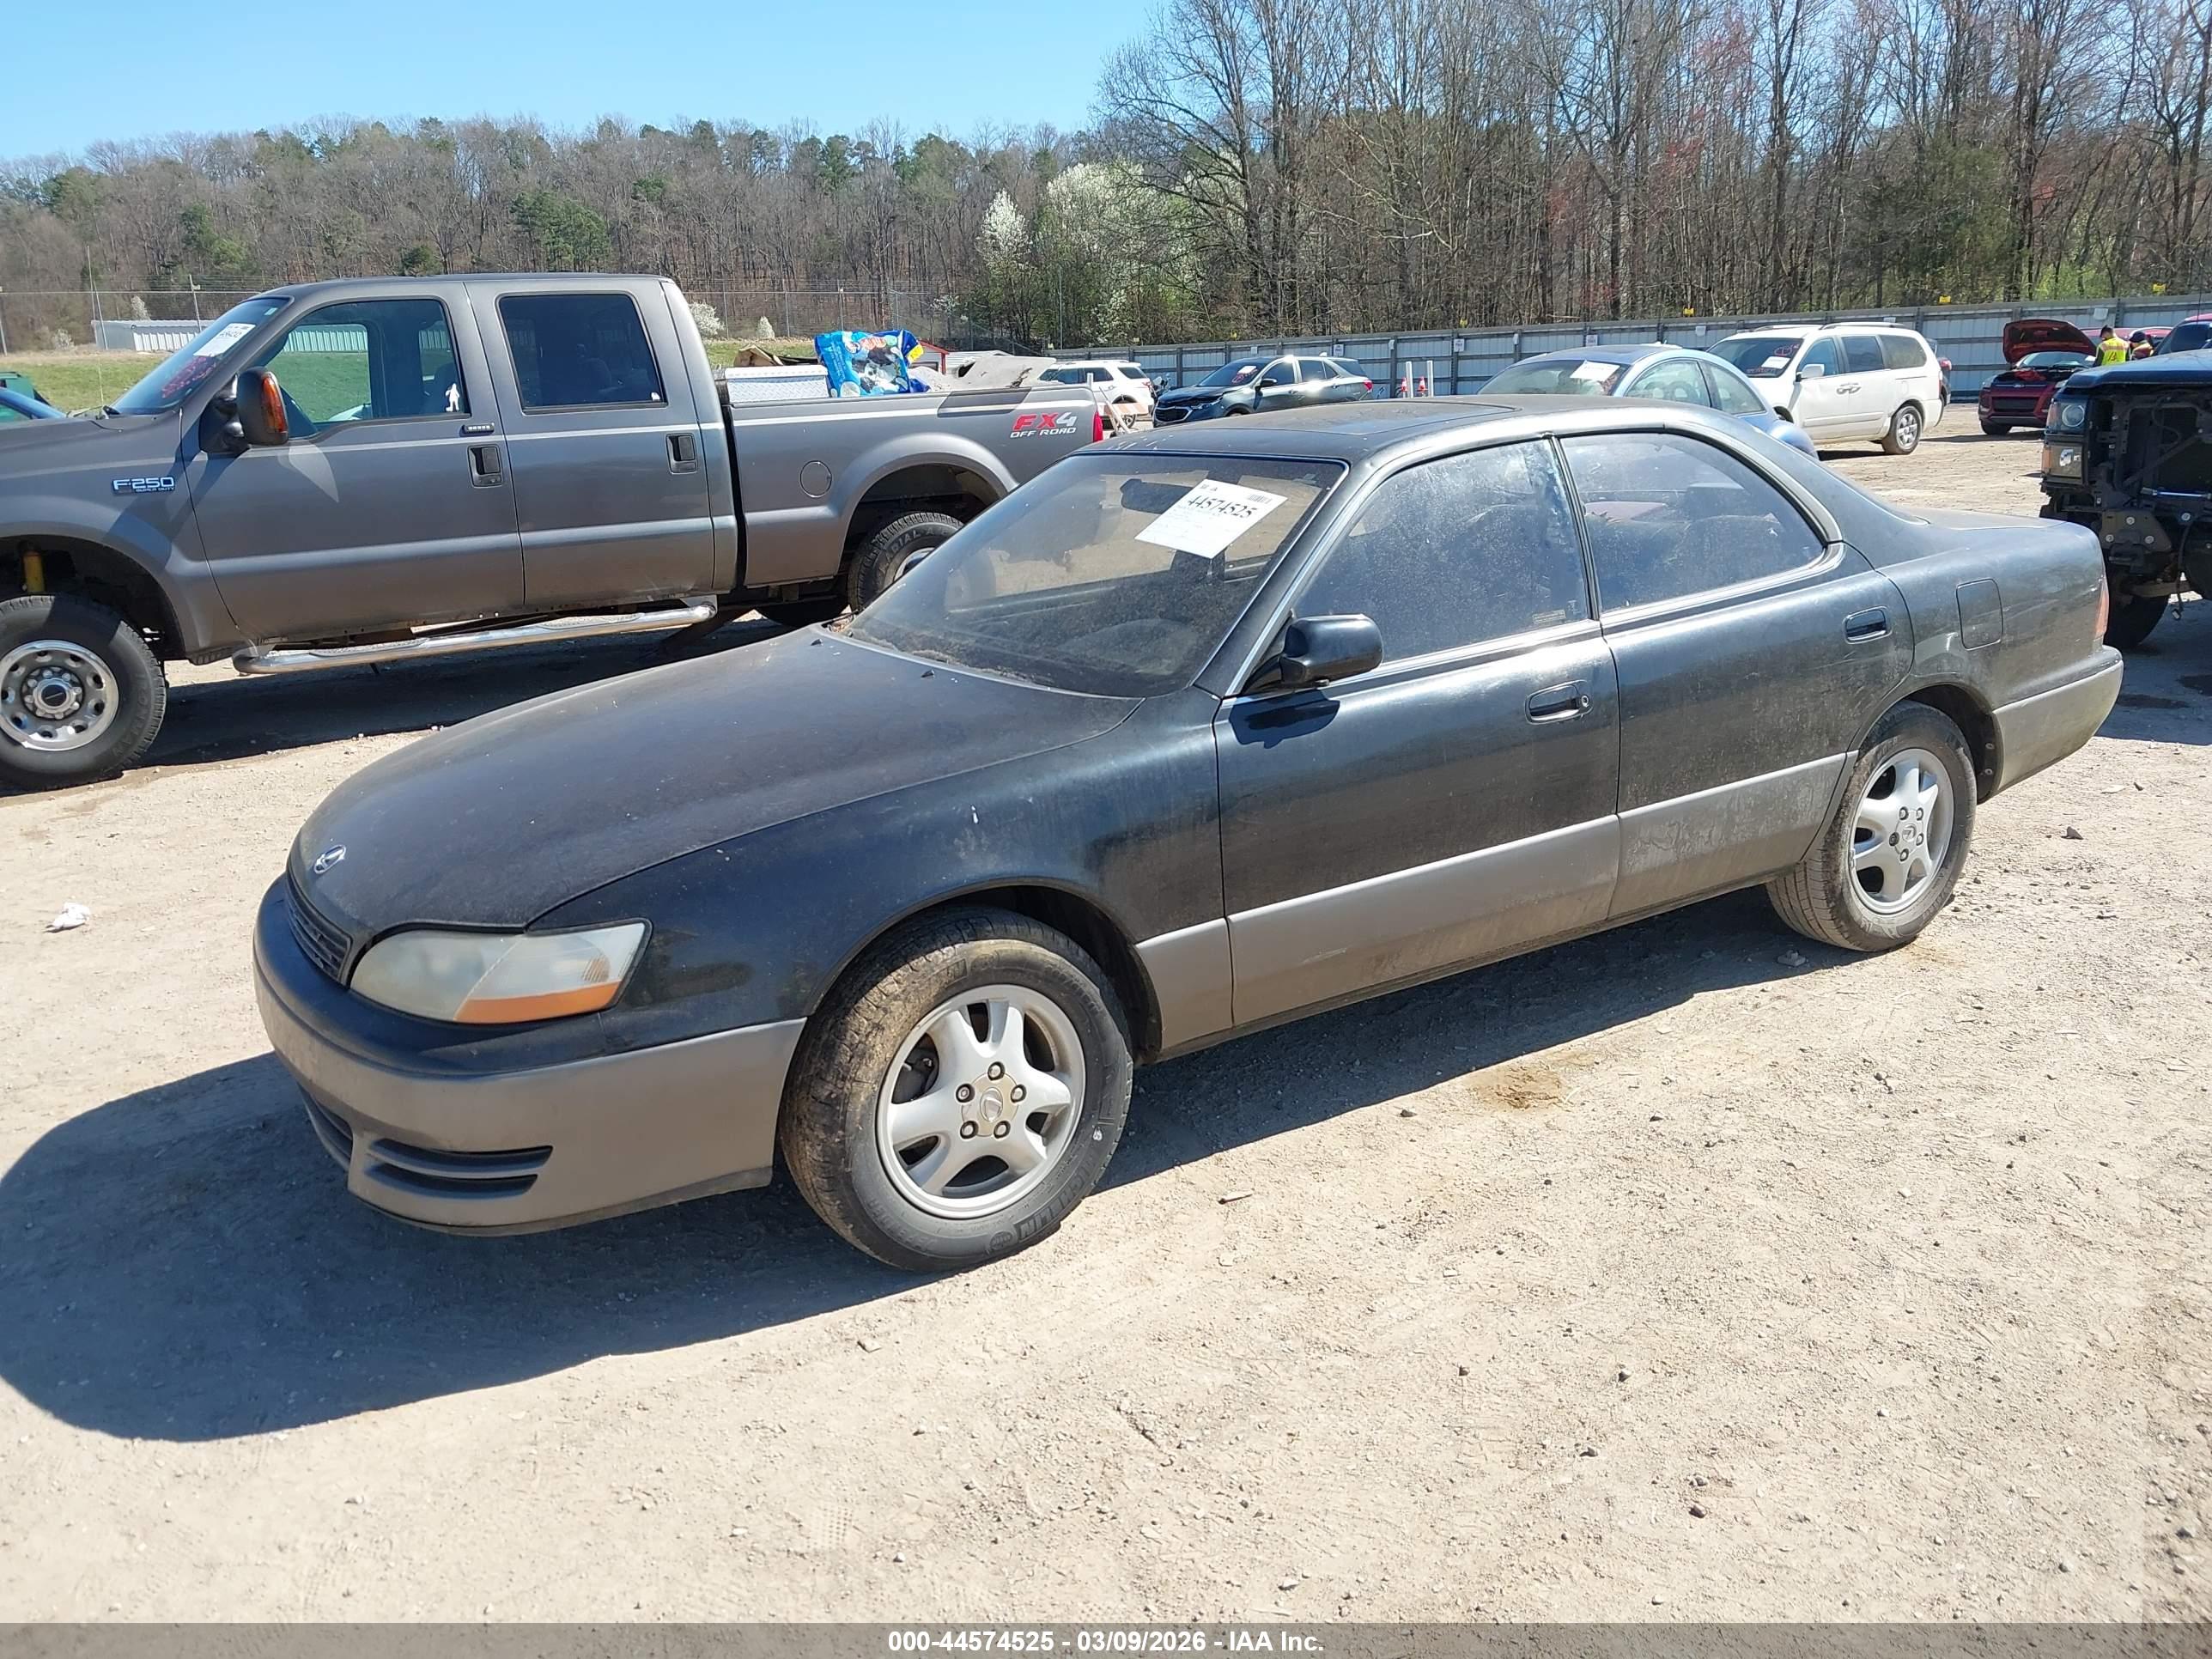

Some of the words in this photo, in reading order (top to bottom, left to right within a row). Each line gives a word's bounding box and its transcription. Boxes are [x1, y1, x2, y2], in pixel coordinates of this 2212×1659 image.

[1012, 411, 1078, 431] FX4
[1010, 430, 1036, 439] OFF
[1039, 427, 1077, 436] ROAD
[1188, 495, 1258, 519] 44574525
